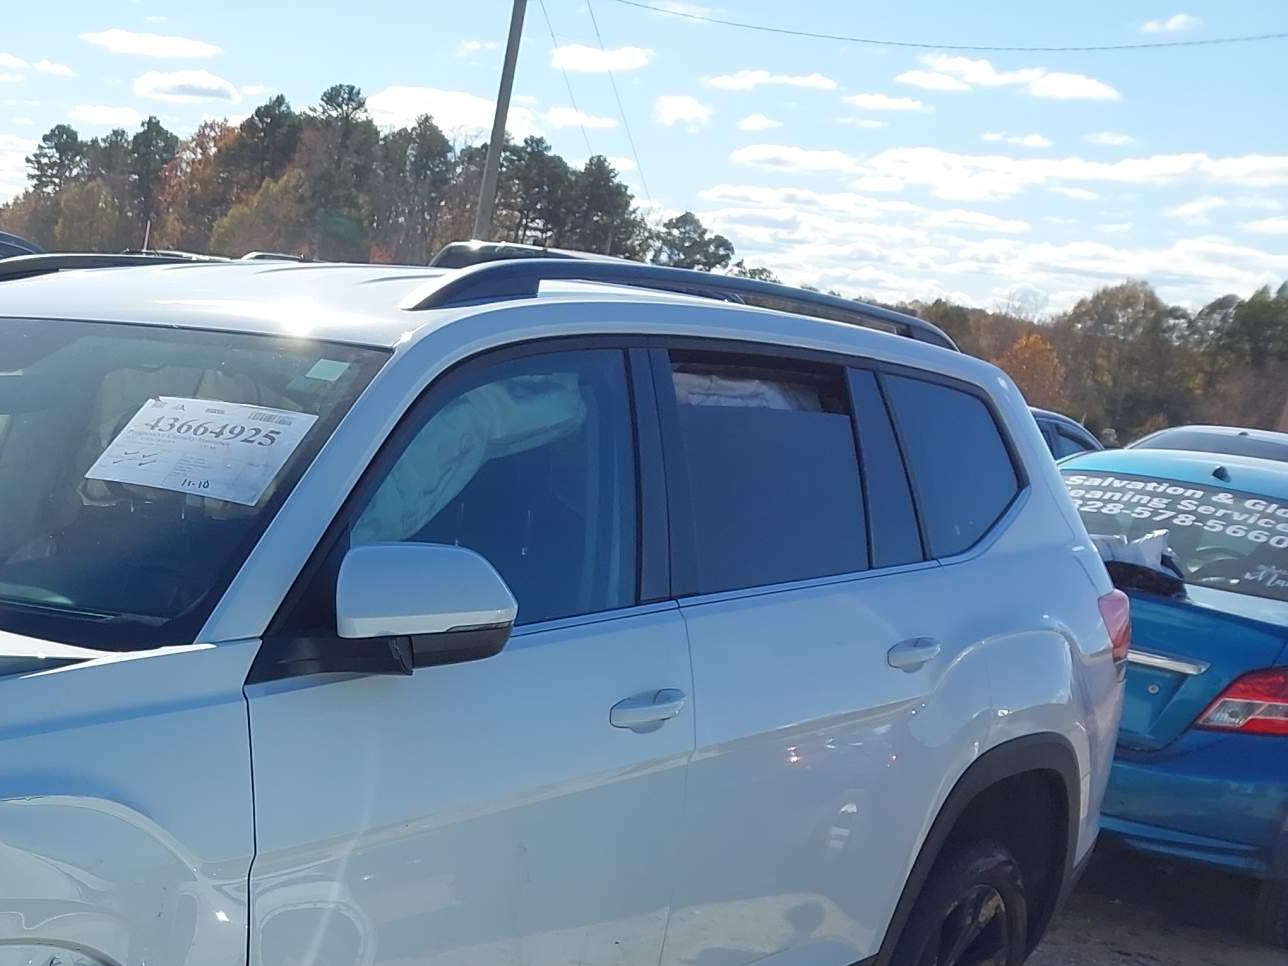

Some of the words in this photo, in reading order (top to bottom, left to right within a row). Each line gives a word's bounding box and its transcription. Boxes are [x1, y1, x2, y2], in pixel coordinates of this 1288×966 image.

[144, 415, 281, 447] 43664925
[181, 479, 210, 490] 11-10
[1065, 475, 1205, 499] Salvation
[1211, 492, 1234, 505] &
[1068, 486, 1173, 510] eaning
